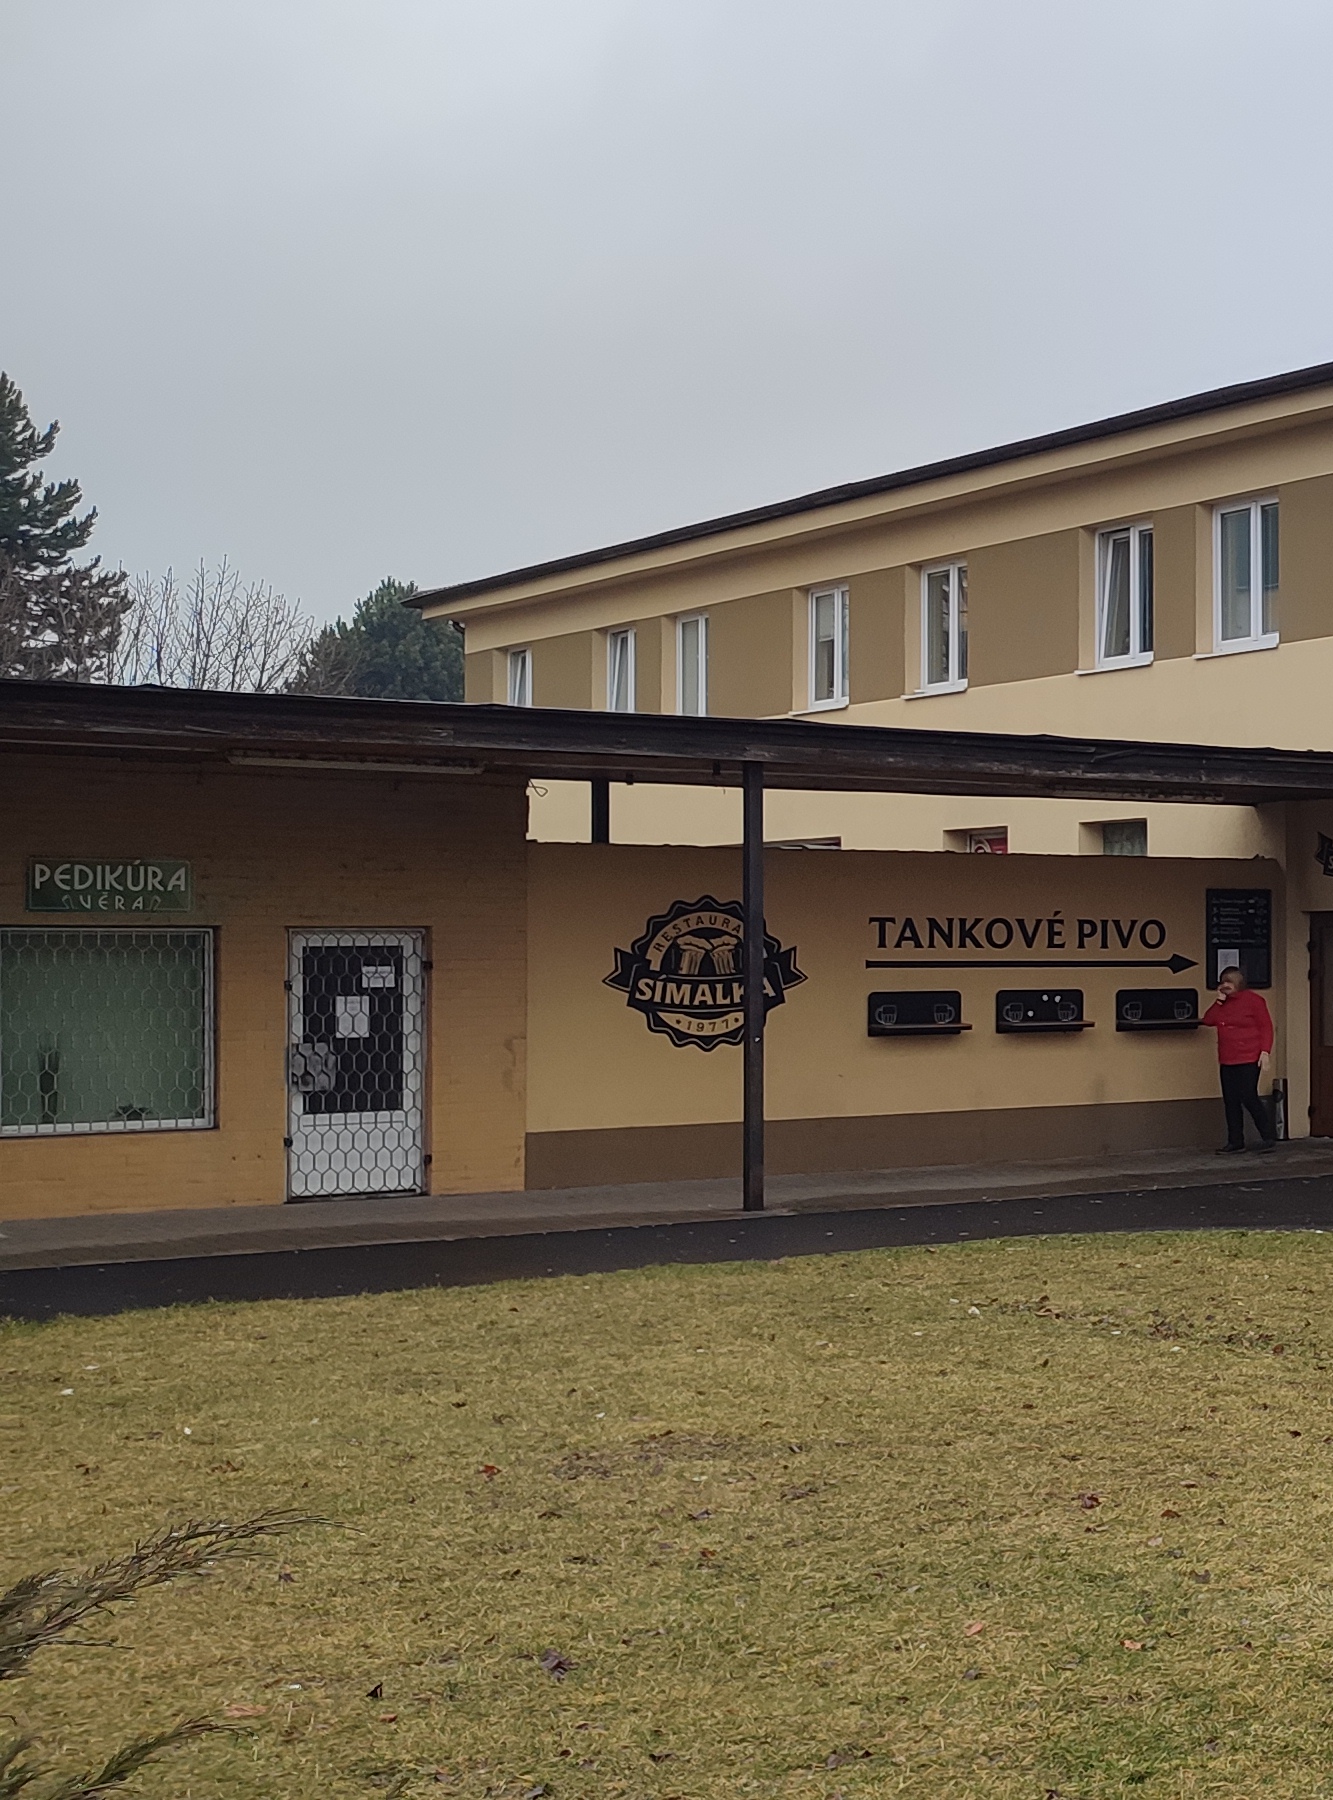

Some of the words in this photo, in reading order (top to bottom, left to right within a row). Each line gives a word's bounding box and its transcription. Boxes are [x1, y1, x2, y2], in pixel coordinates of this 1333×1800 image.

[34, 859, 187, 892] PEDIKÚRA
[79, 891, 144, 911] VĚRA
[653, 914, 744, 953] RESTAURA
[870, 910, 1066, 949] TANKOVÉ
[1077, 919, 1167, 949] PIVO
[686, 1019, 730, 1032] 1977
